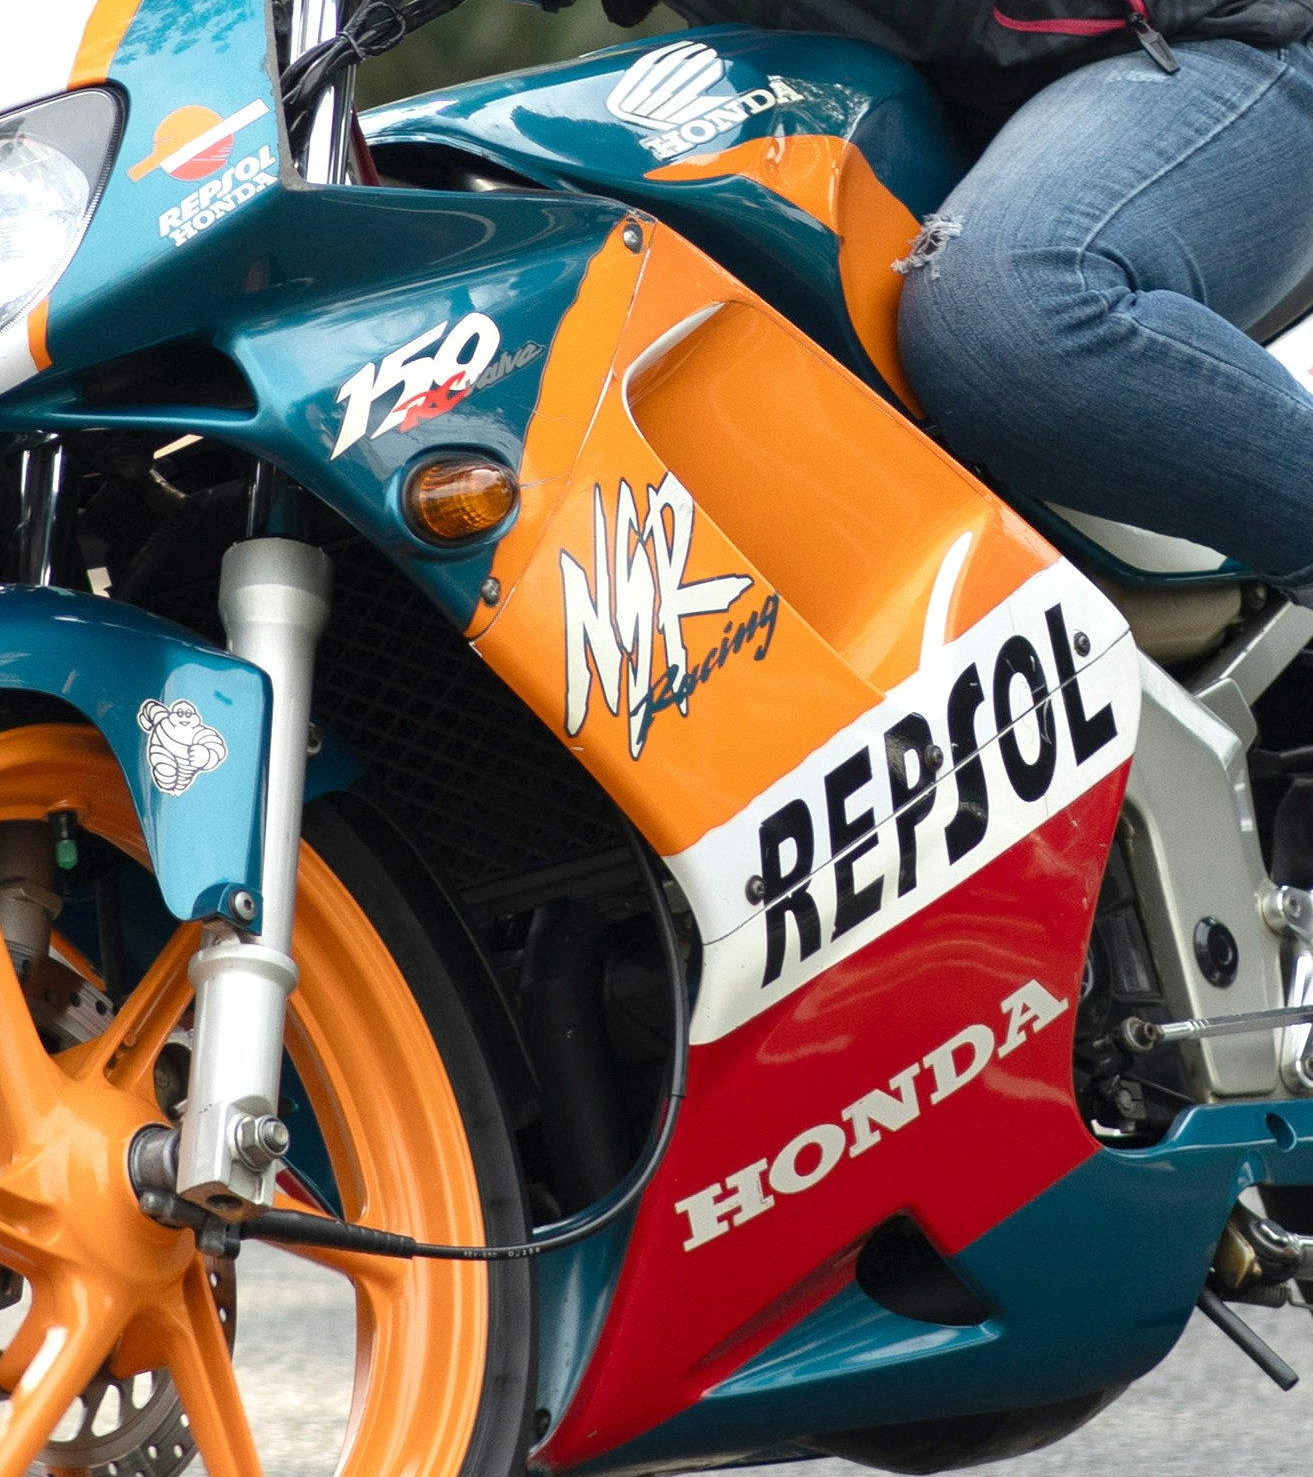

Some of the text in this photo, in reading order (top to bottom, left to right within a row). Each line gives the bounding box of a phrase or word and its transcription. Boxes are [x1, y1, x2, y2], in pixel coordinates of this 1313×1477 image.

[159, 144, 276, 237] REPSOL
[643, 76, 806, 161] HONDA
[169, 172, 278, 247] HONDA
[329, 311, 501, 461] 150
[558, 470, 755, 762] NSR
[629, 590, 780, 746] Racing
[757, 602, 1120, 990] REPSOL
[674, 978, 1070, 1253] HONDA
